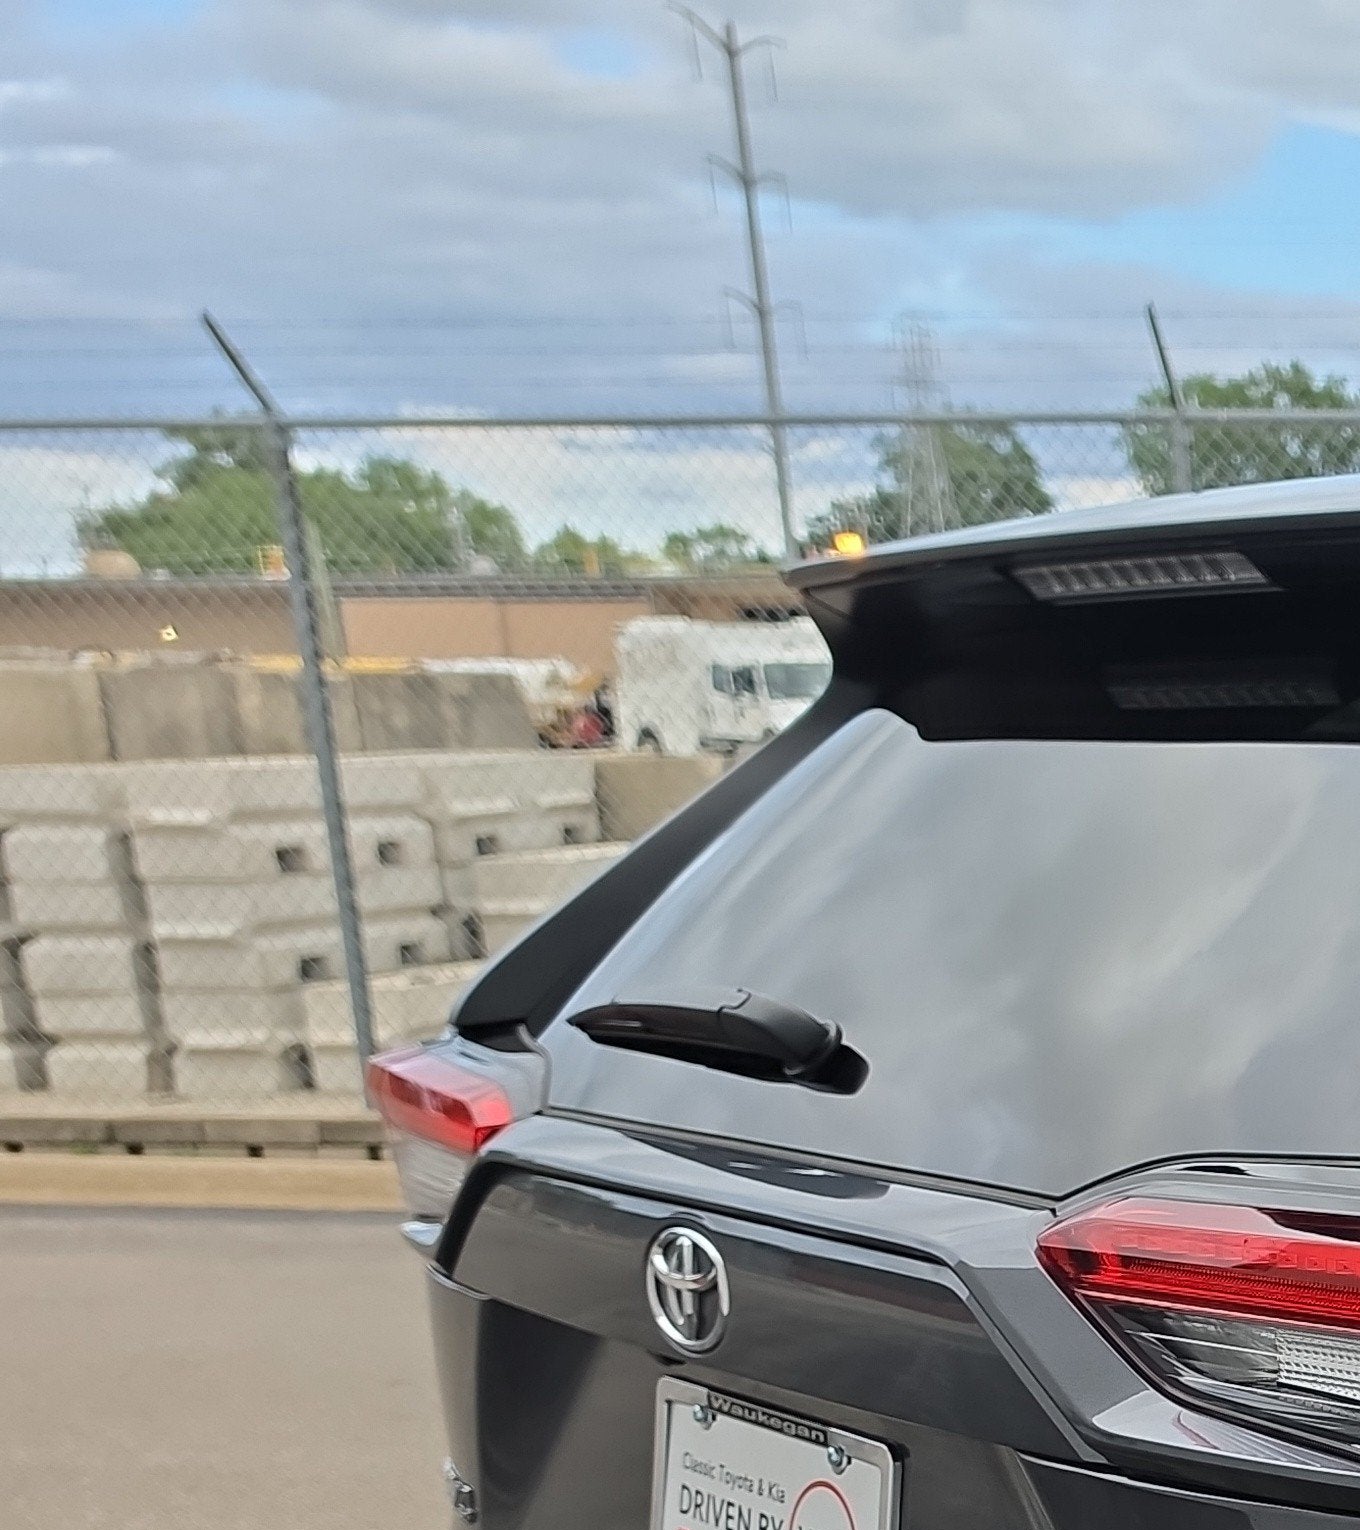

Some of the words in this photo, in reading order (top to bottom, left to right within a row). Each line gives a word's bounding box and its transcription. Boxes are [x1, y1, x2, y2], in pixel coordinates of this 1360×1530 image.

[709, 1394, 825, 1443] Waukegan
[719, 1464, 753, 1493] Toyota
[768, 1481, 785, 1503] Kia
